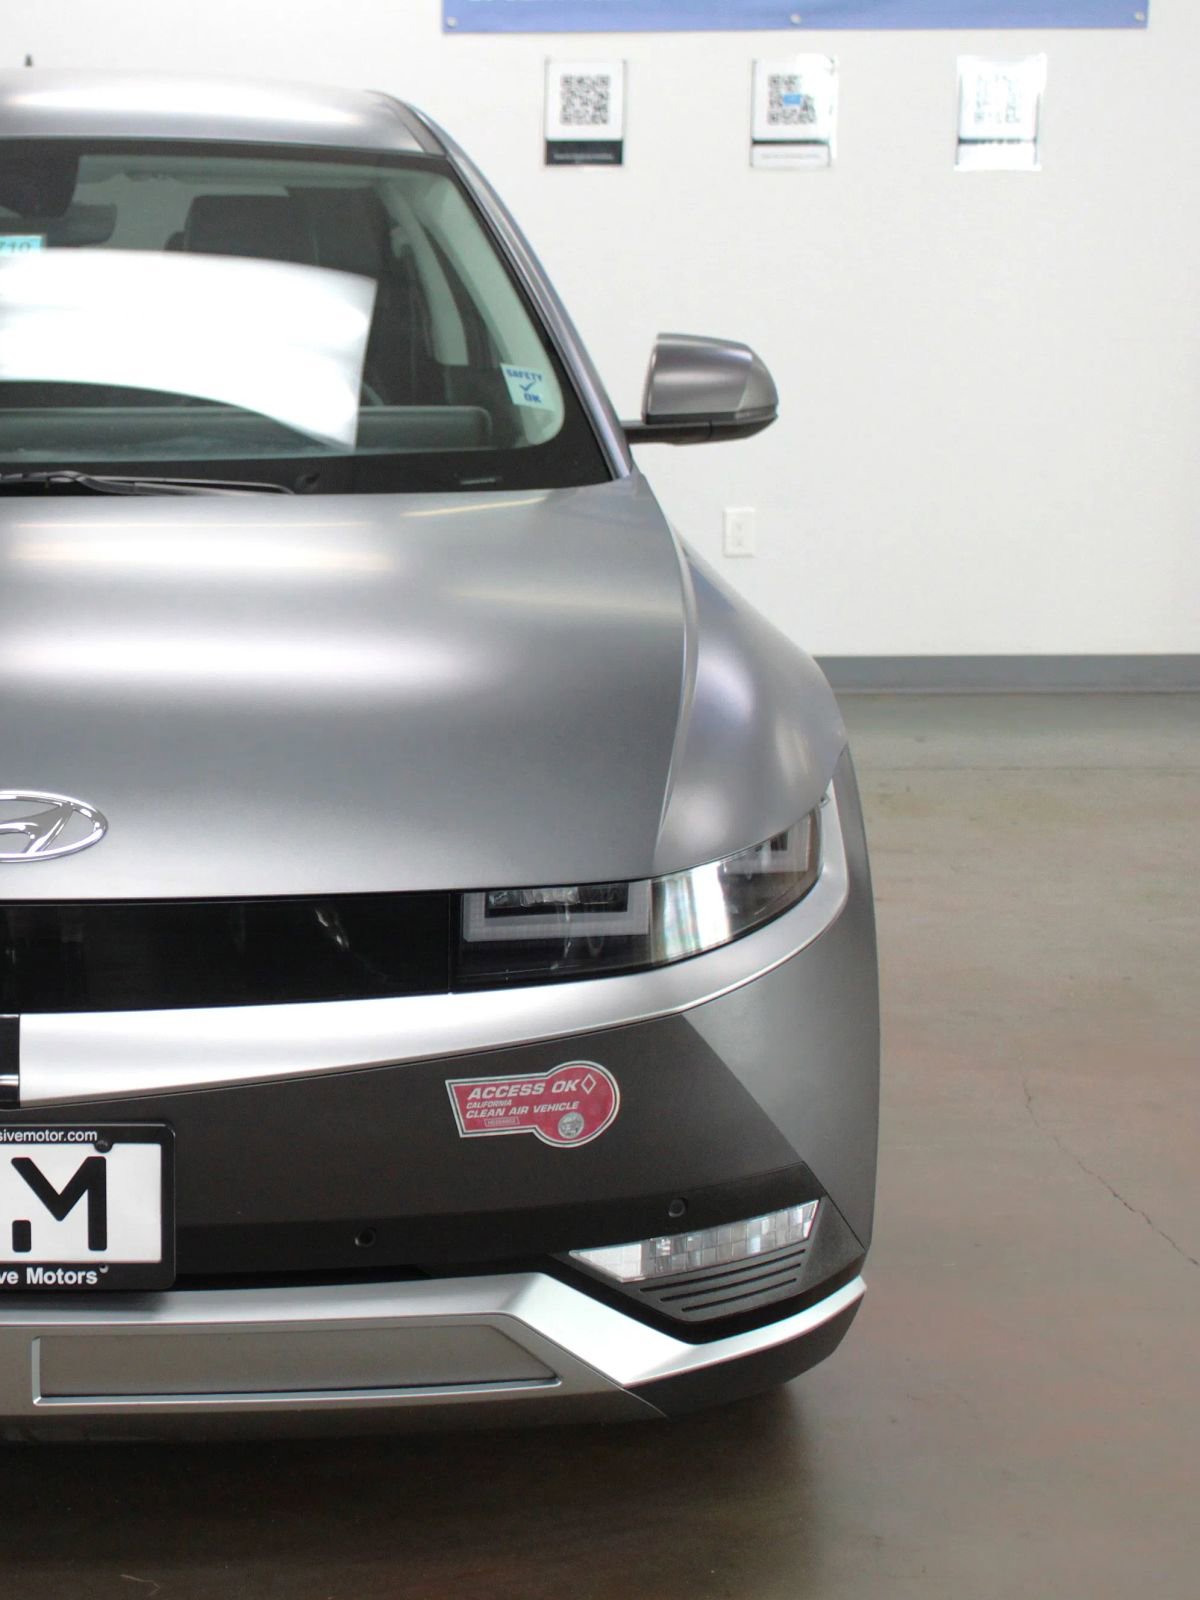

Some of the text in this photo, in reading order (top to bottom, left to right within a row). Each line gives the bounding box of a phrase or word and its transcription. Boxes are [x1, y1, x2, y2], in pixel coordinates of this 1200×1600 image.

[506, 369, 542, 381] SAFETY
[524, 393, 542, 403] OK
[467, 1079, 580, 1100] ACCESS OK
[465, 1100, 580, 1119] CLEAN AIR VEHICLE
[466, 1099, 512, 1110] CALIFORNIA
[26, 1268, 98, 1285] Motors
